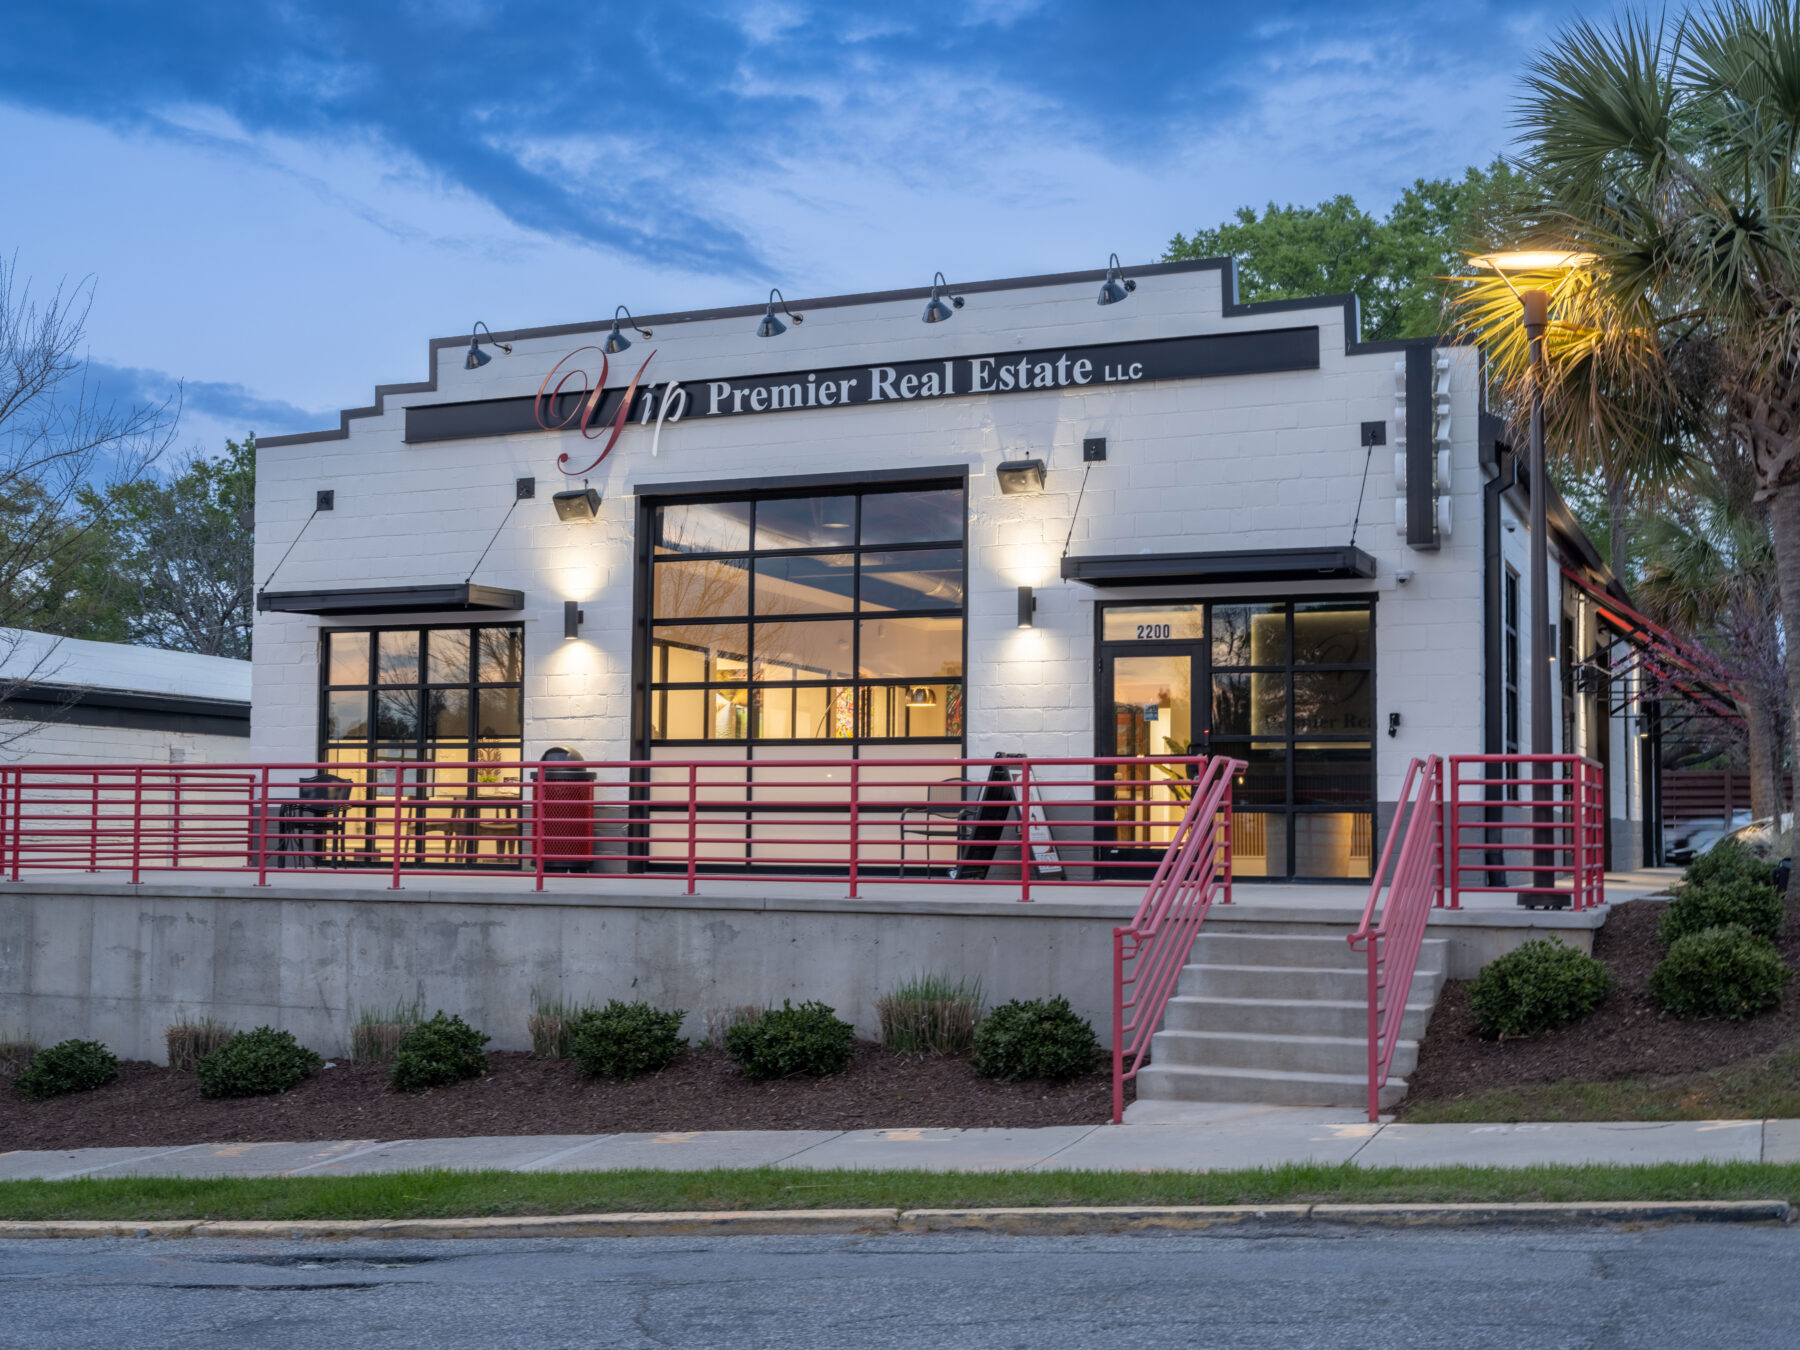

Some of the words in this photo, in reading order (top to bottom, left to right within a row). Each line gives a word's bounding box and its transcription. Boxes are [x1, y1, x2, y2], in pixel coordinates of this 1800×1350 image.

[534, 345, 687, 476] Yip
[706, 373, 858, 415] Premier
[867, 361, 956, 401] Real
[967, 353, 1094, 393] Estate
[1104, 362, 1144, 382] LLC
[1137, 623, 1170, 639] 2200
